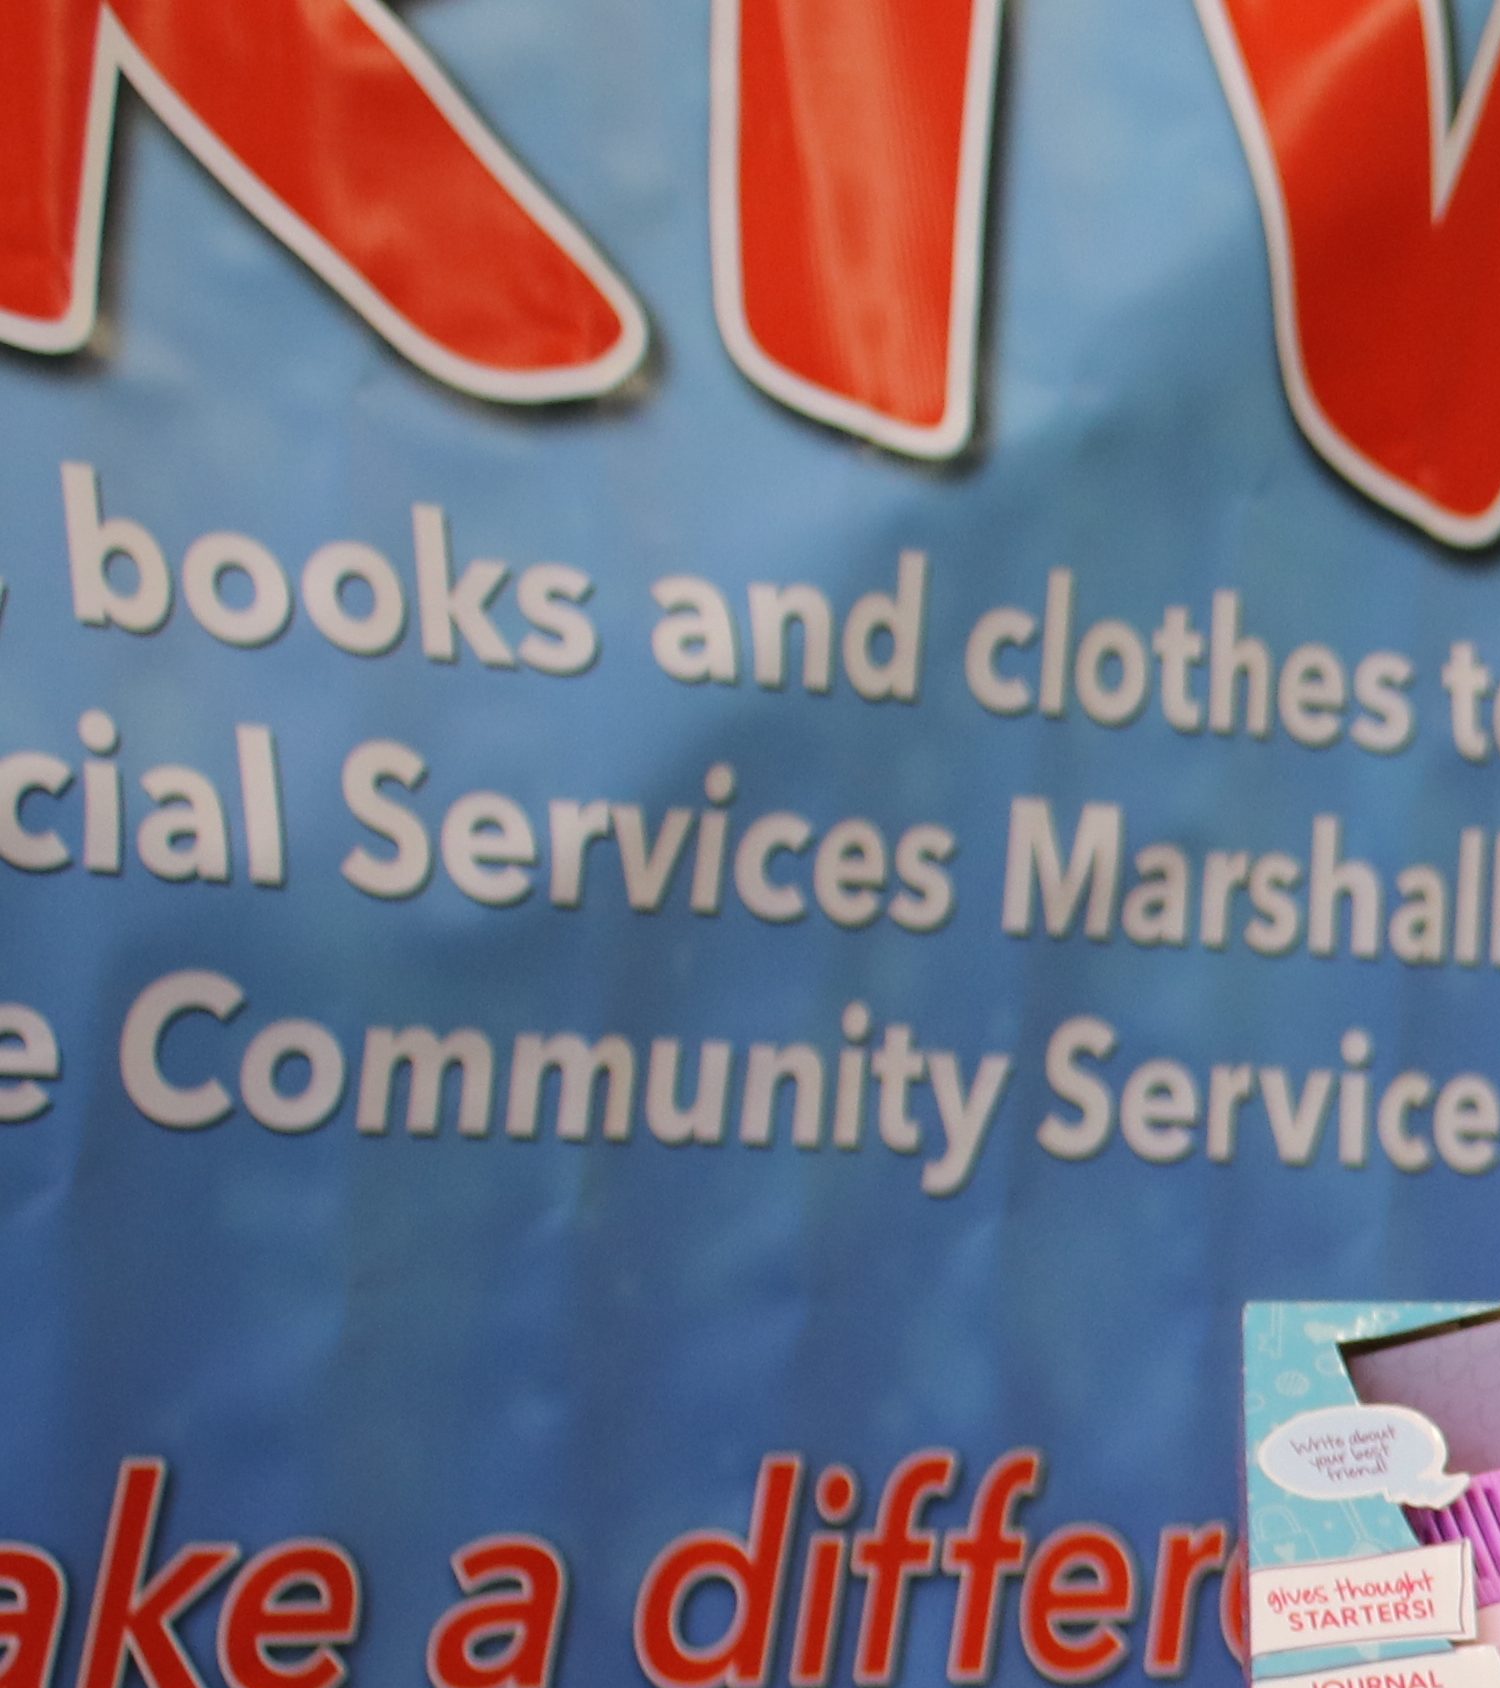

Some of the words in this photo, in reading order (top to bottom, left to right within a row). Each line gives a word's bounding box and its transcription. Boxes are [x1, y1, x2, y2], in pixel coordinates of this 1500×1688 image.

[60, 461, 600, 676] books
[650, 551, 929, 701] and
[965, 567, 1413, 755] clothes
[339, 739, 958, 933] Services
[119, 970, 1009, 1197] Community
[1267, 1579, 1330, 1614] gives
[1334, 1569, 1435, 1603] thought
[1288, 1599, 1436, 1633] STARTERS!
